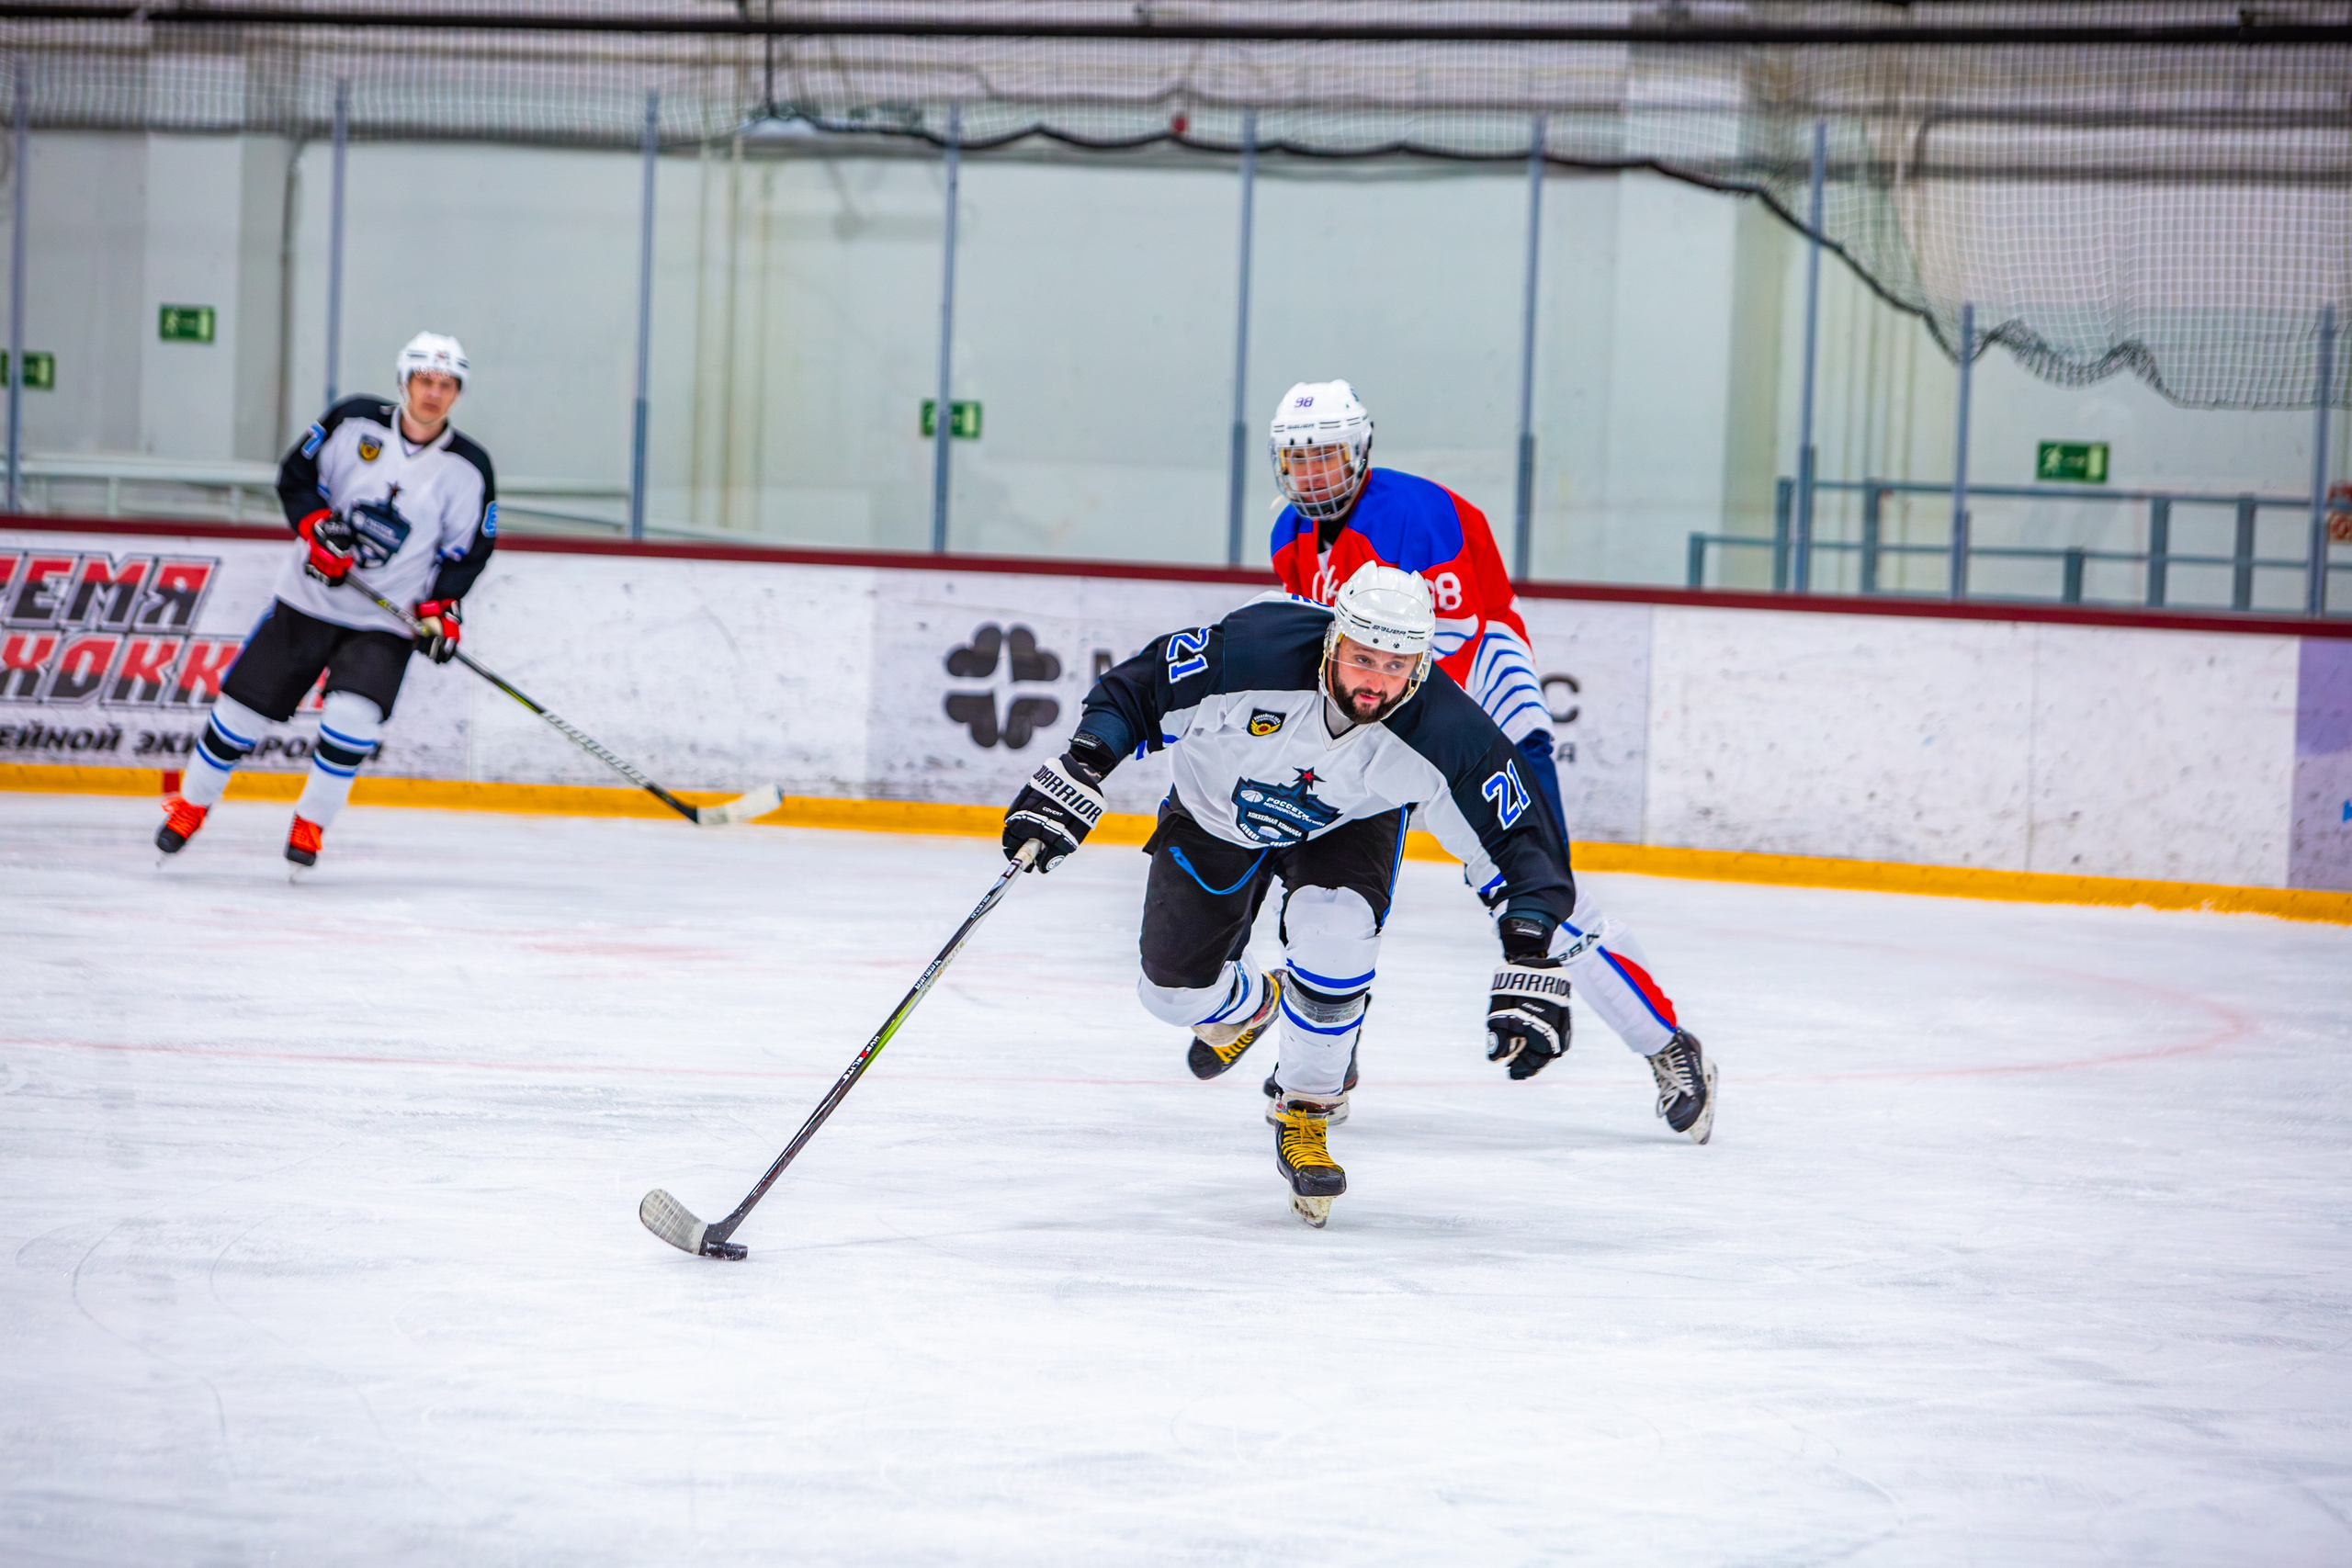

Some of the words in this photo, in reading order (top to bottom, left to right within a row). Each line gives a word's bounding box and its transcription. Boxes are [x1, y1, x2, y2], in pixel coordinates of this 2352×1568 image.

[1294, 396, 1314, 409] 98
[0, 633, 329, 710] ХОКК
[1166, 627, 1212, 684] 21
[1032, 764, 1102, 824] WARRIOR
[1042, 806, 1064, 817] COVERT
[1266, 796, 1310, 819] РОССЕТИ
[1481, 758, 1532, 830] 21
[1247, 811, 1279, 826] ХОККЕЙНАЯ
